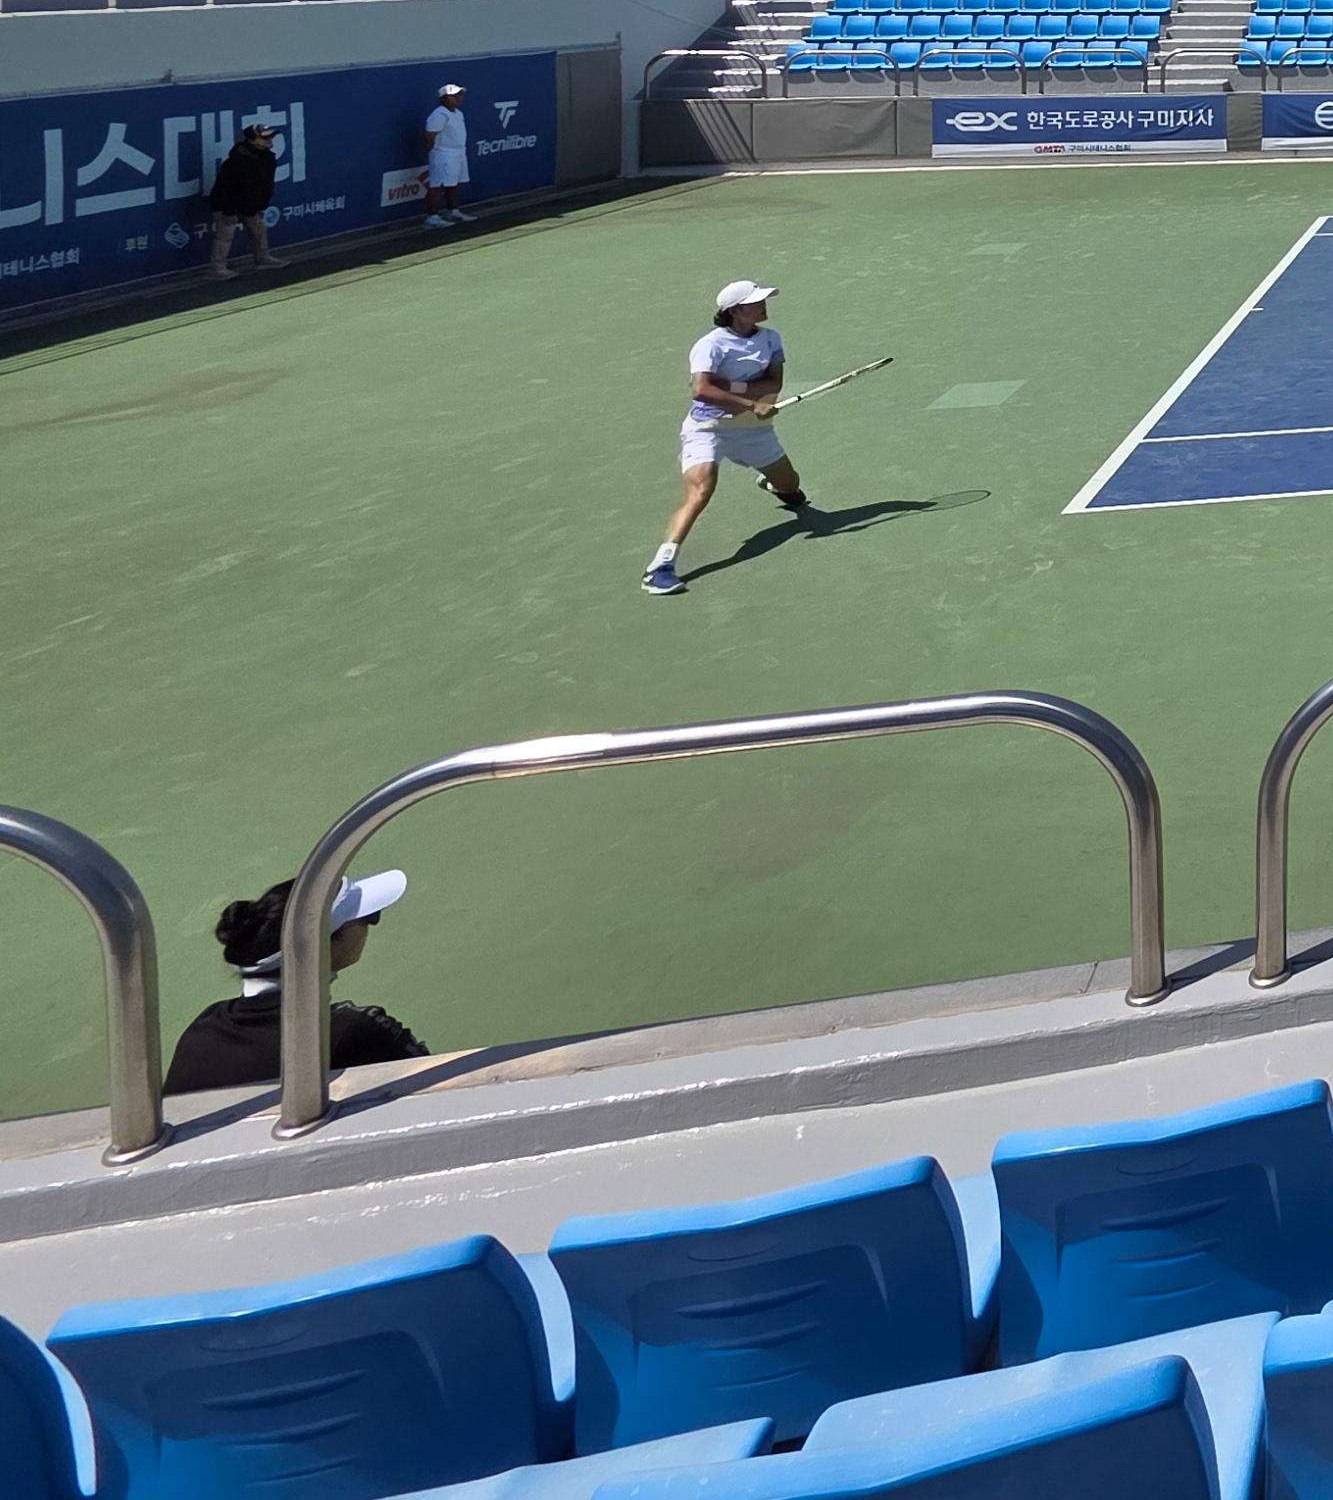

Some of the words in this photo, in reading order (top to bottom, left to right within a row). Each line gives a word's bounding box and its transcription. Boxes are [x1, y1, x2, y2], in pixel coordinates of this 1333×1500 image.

[946, 111, 1018, 132] ex
[1027, 110, 1134, 130] 한국도로공사
[1138, 109, 1214, 128] 구미지사
[388, 183, 420, 201] vitro
[0, 247, 80, 280] 테니스협회
